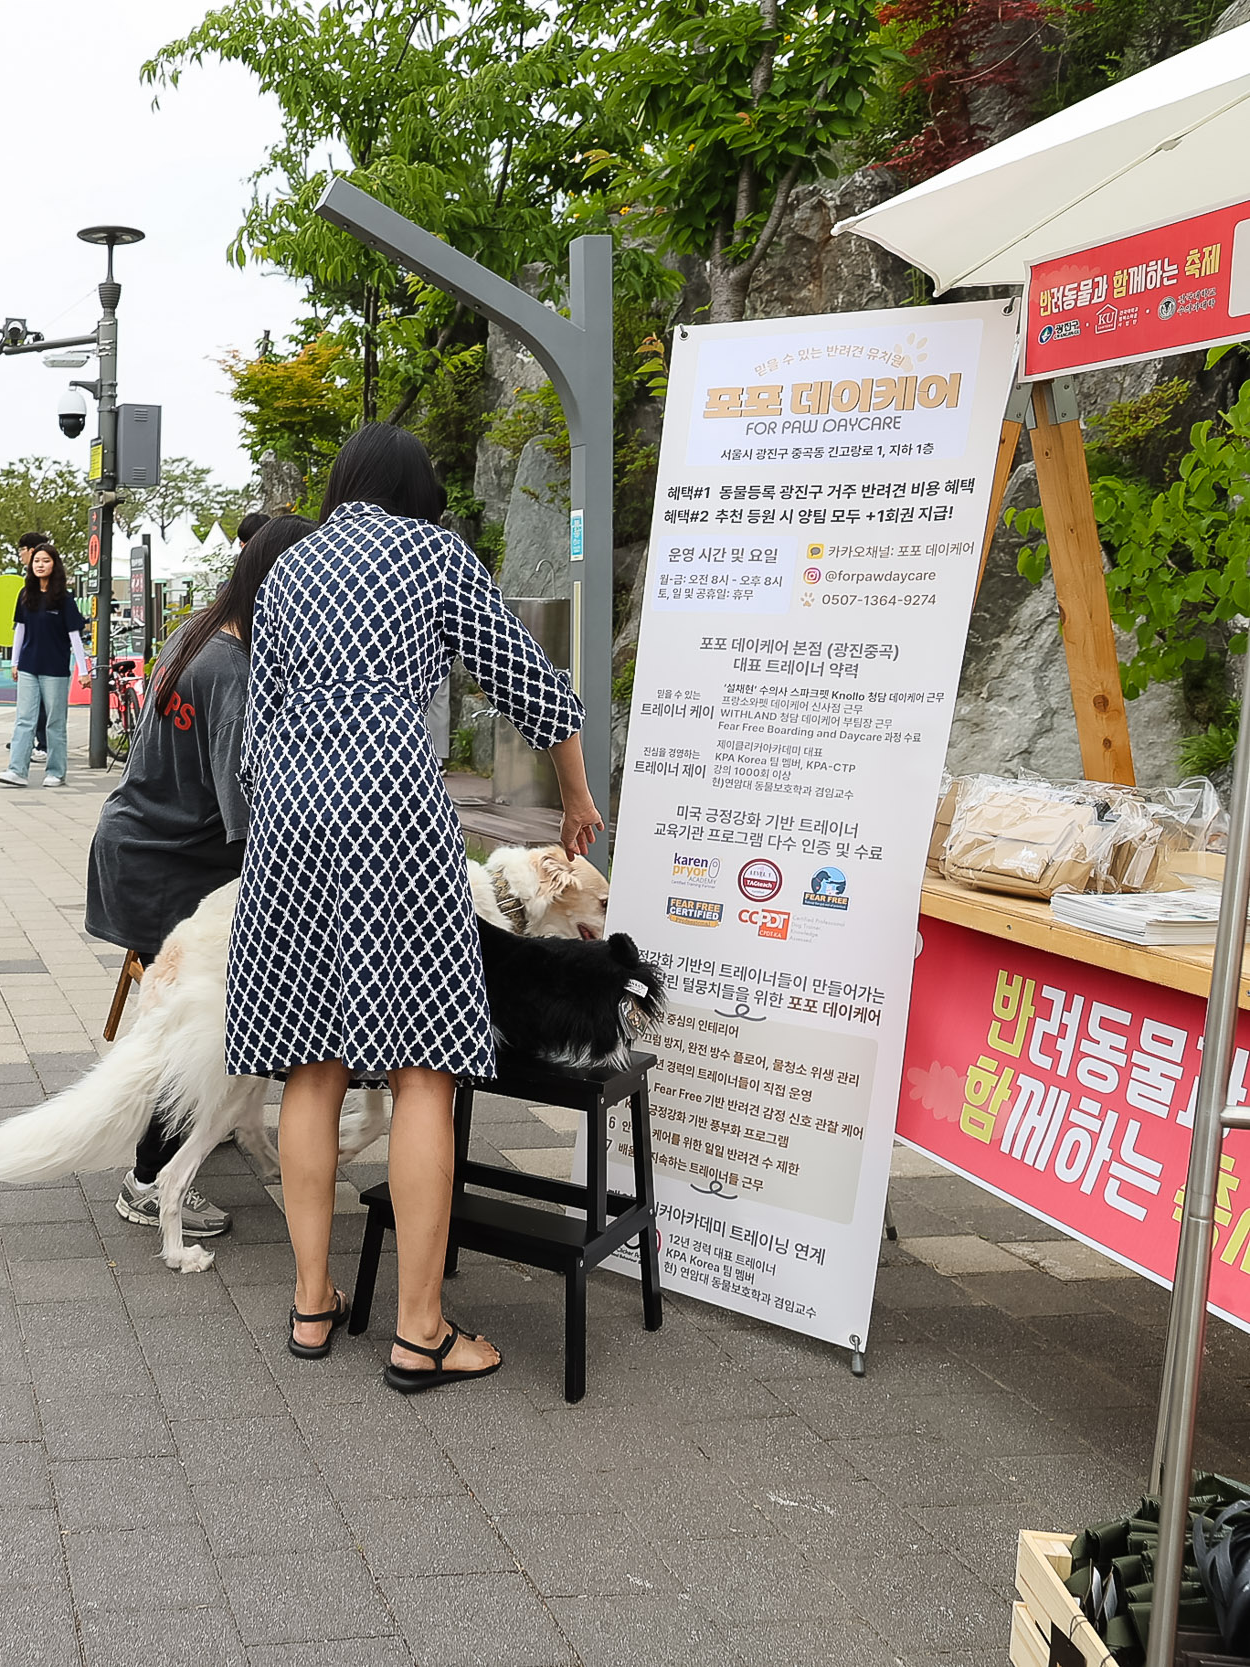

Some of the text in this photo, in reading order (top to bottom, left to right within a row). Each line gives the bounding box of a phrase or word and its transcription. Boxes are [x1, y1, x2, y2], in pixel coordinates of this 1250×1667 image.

[1039, 243, 1222, 317] 반려동물과 함께하는 축제
[703, 372, 962, 419] 포포 데이케어
[746, 415, 902, 435] FOR PAW DAYCARE
[720, 442, 934, 461] 서울시 광진구 중곡동 긴고랑로 1, 지하 1층
[667, 478, 975, 501] 혜택#1 동물등록 광진구 거주 반려견 비용 혜택
[663, 505, 954, 525] 혜택#2 추천 등원 시 양팀 모두 +1회권 지급!
[668, 547, 778, 563] 운영 시간 및 요일
[828, 541, 975, 559] 카카오채널: 포포 데이케어
[824, 569, 936, 584] @forpawdaycare
[658, 588, 754, 600] 토, 일 및 공휴일: 휴무
[822, 593, 936, 606] 0507-1364-9274
[699, 637, 899, 661] 포포 데이케어 본점 (광진중곡)
[733, 657, 859, 679] 대표 트레이너 약력
[640, 703, 714, 720] 트레이너 케이
[720, 708, 892, 729] WITHLAND 청담 데이케어 부팀장 근무
[718, 721, 921, 743] Fear Free Boarding and Daycare 과정 수료
[634, 760, 707, 779] 트레이너 제이
[713, 764, 791, 781] 강의 1000회 이상
[715, 752, 856, 773] KPA Korea 팀 멤버, KPA-CTP
[676, 805, 859, 839] 미국 긍정강화 기반 트레이너
[654, 822, 883, 861] 교육기관 프로그램 다수 인증 및 수료
[674, 852, 708, 868] karen
[672, 865, 707, 877] pryor
[689, 877, 717, 885] ACADEMY
[671, 898, 720, 912] FEAR FREE
[805, 893, 826, 902] FEAR
[827, 896, 848, 905] FREE
[670, 907, 719, 920] CERTIFIED
[738, 909, 789, 930] CCPDT
[639, 949, 886, 1005] 정강화 기반의 트레이너들이 만들어가는
[682, 976, 882, 1026] 털뭉치들을 위한 포포 데이케어
[667, 1013, 695, 1029] 중심의
[698, 1020, 739, 1038] 인테리어
[664, 1037, 686, 1053] 방지,
[688, 1042, 709, 1057] 완전
[710, 1046, 730, 1061] 방수
[733, 1051, 769, 1071] 플로어,
[810, 1066, 834, 1082] 위생
[837, 1071, 860, 1087] 관리
[667, 1060, 812, 1103] 경력의 트레이너들이 직접 운영
[654, 1082, 864, 1141] Fear Free 기반 반려견 감정 신호 관찰 케어
[649, 1104, 790, 1149] 긍정강화 기반 풍부화 프로그램
[959, 1055, 1164, 1223] 함께하는
[668, 1234, 777, 1276] 12년 경력 대표 트레이너
[729, 1226, 789, 1256] 트레이닝
[794, 1242, 826, 1266] 연계
[666, 1247, 755, 1285] KPA Korea 팀 멤버
